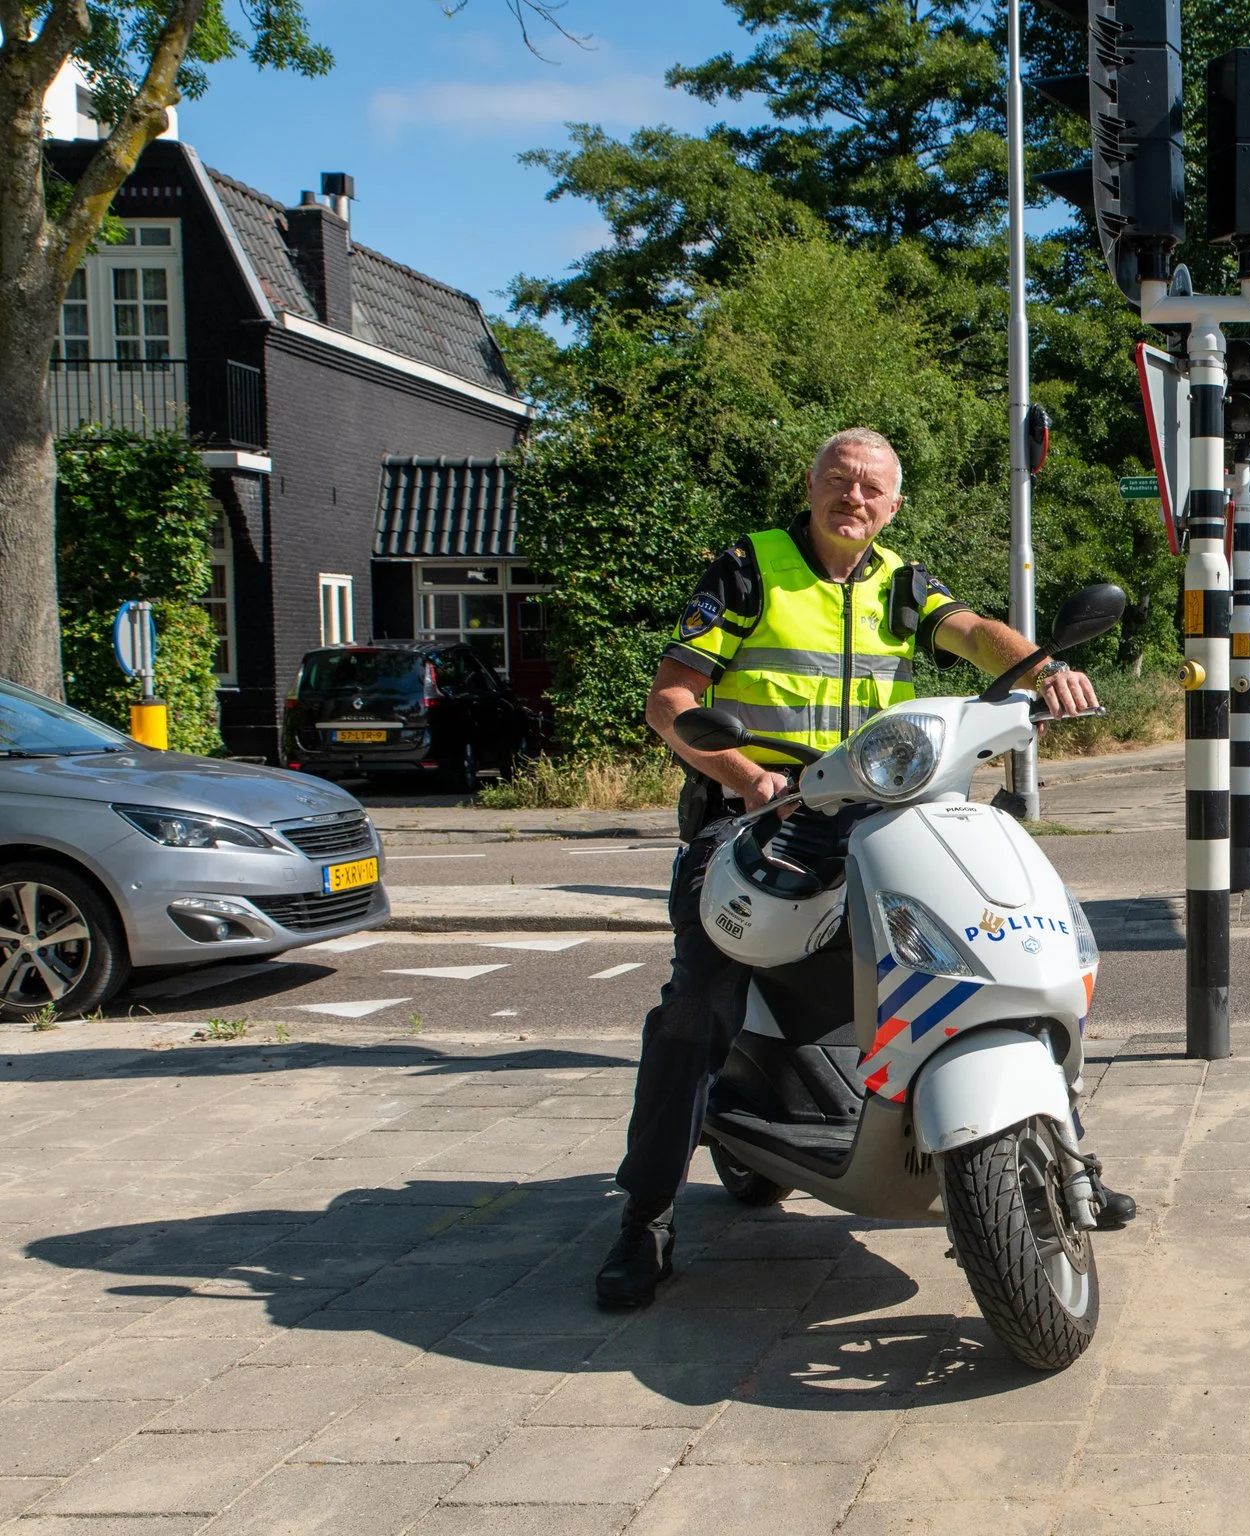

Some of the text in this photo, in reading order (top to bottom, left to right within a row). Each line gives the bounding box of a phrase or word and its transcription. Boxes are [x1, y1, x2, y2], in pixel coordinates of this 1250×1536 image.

[340, 731, 382, 740] 57-LTR-9
[335, 861, 374, 887] 5-XRV-10
[718, 917, 740, 936] agv
[964, 915, 1070, 942] POLITIE
